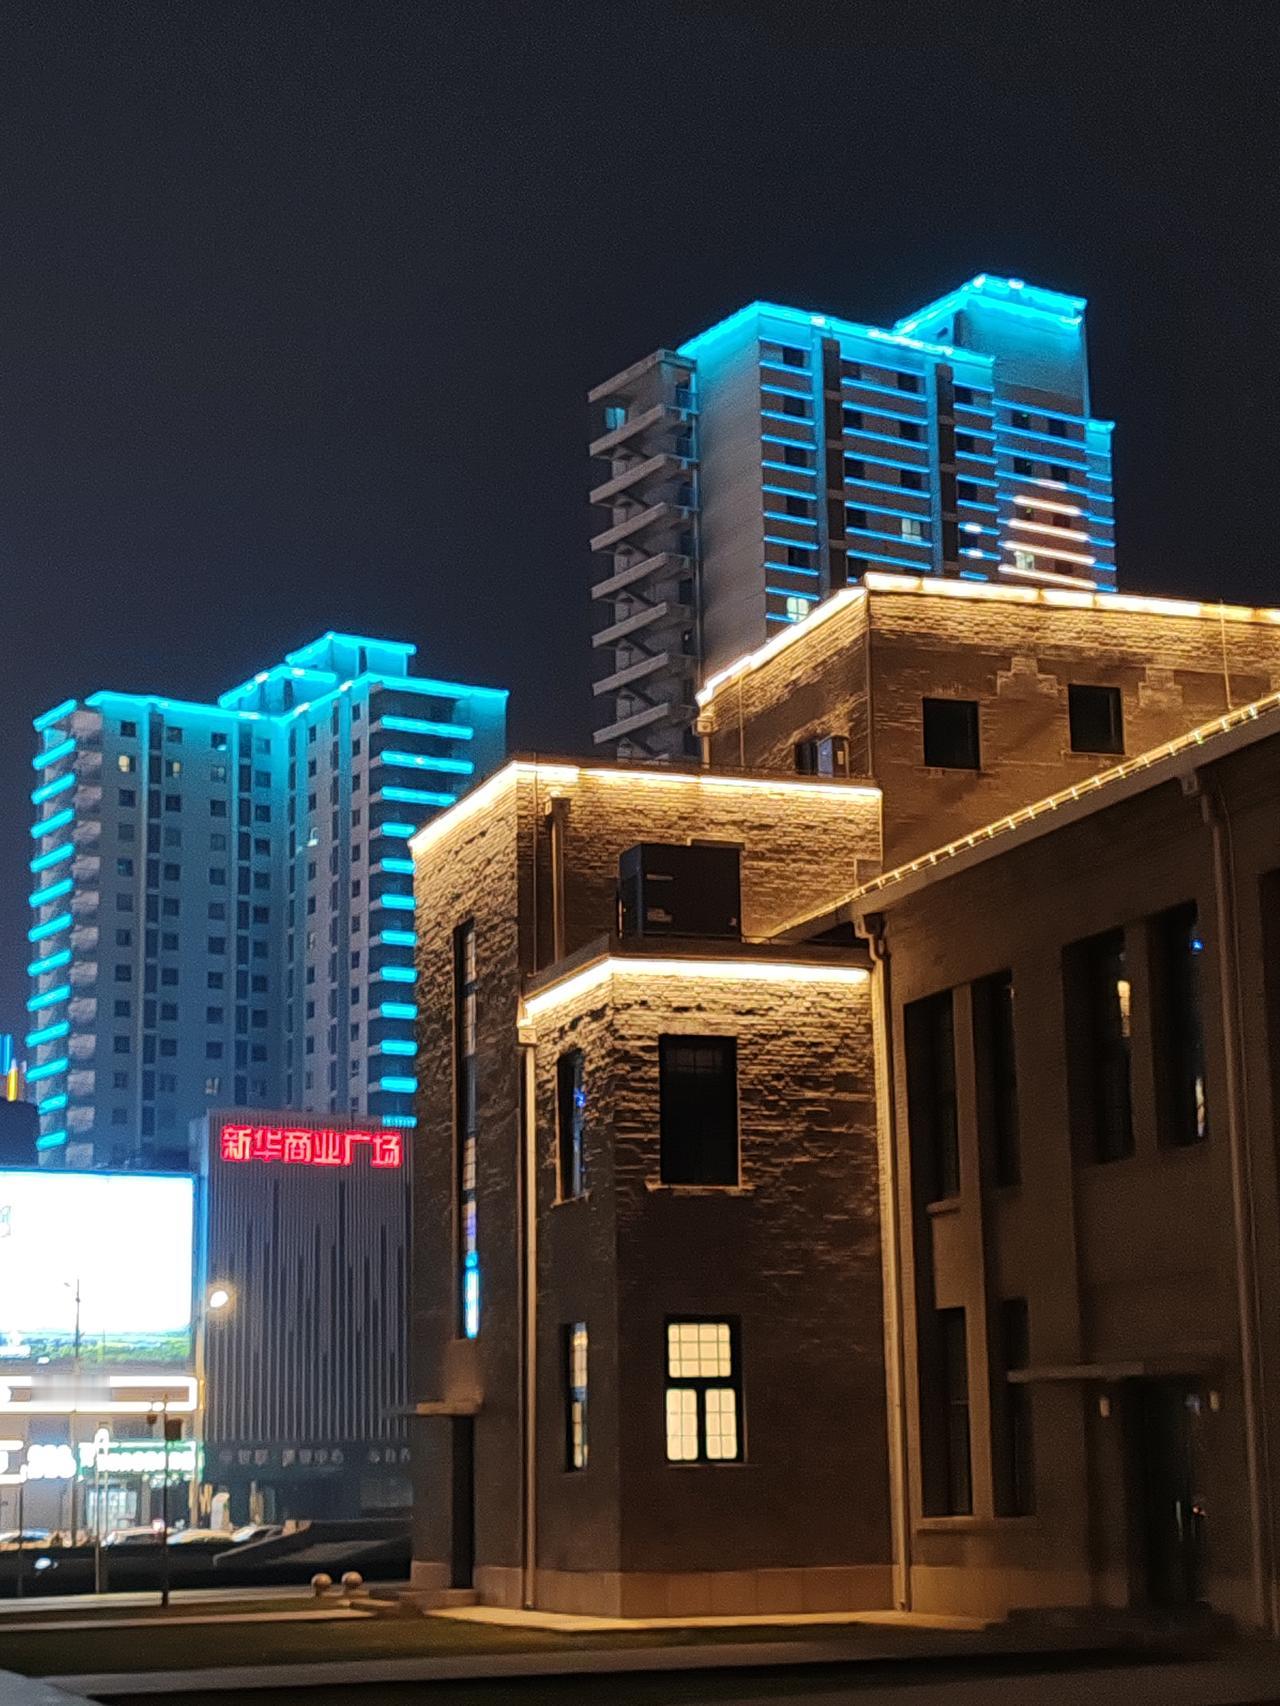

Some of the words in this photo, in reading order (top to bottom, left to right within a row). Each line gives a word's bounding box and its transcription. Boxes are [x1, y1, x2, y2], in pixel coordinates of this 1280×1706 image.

[222, 1125, 402, 1167] 新华商业广场
